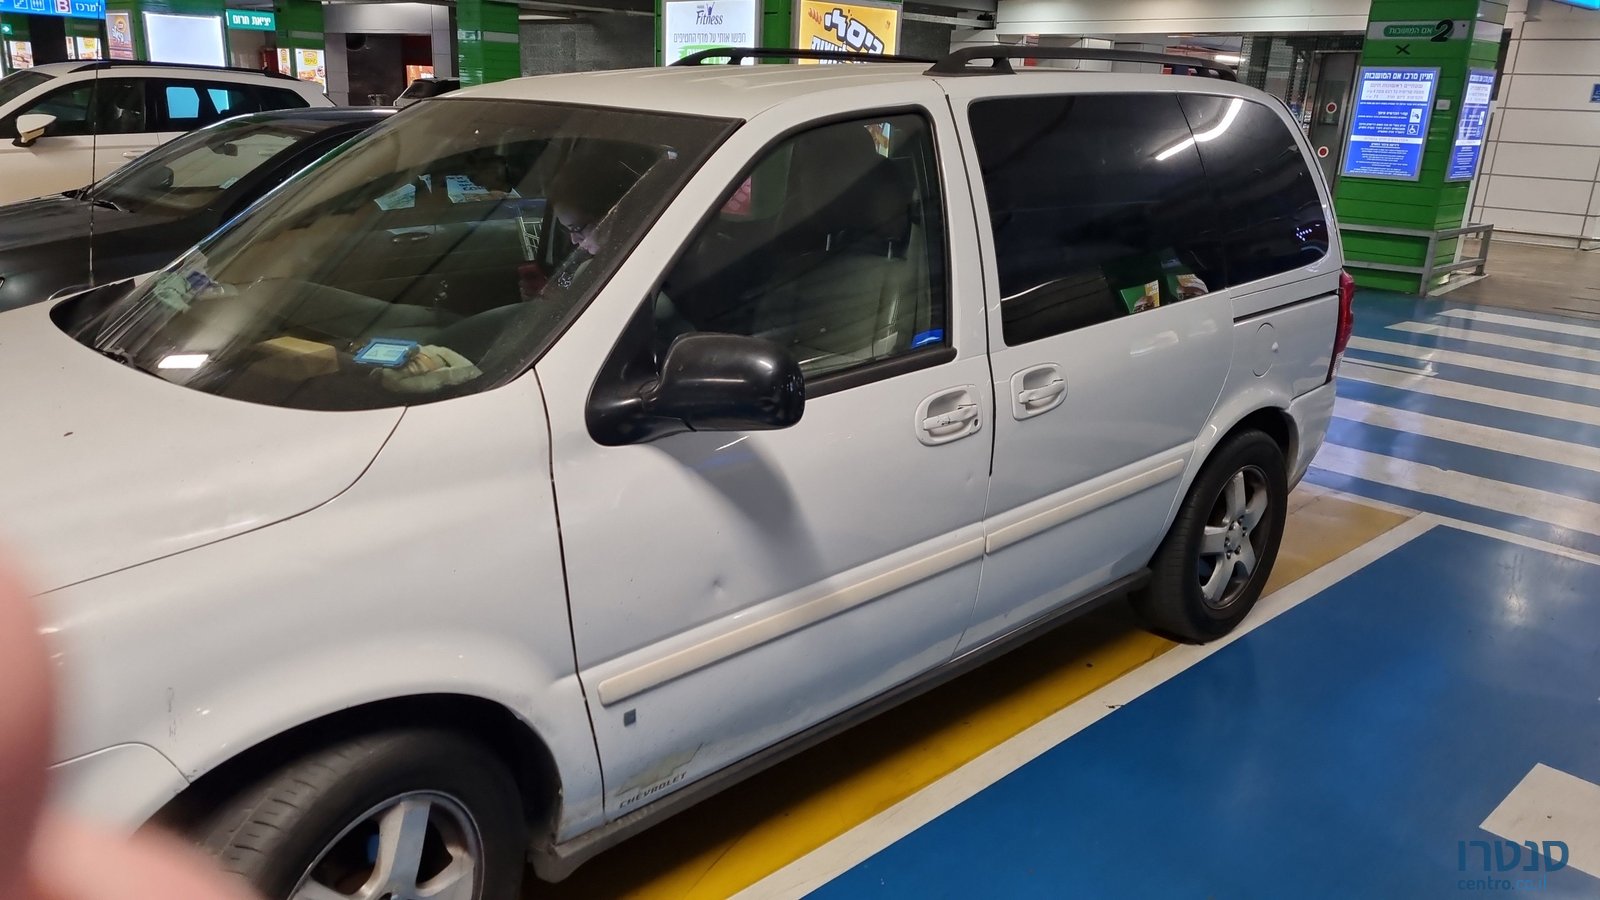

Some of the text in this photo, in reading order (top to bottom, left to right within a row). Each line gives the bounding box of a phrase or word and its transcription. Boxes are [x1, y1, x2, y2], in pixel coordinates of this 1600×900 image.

[232, 14, 272, 26] יציאת חרום
[696, 9, 724, 25] Fitness
[1430, 19, 1454, 42] 2
[709, 33, 717, 43] על
[717, 33, 731, 43] אותי
[1364, 72, 1392, 80] המושבות
[1393, 72, 1402, 80] אם
[1419, 72, 1434, 81] חניון
[619, 771, 688, 808] CHEVROLET
